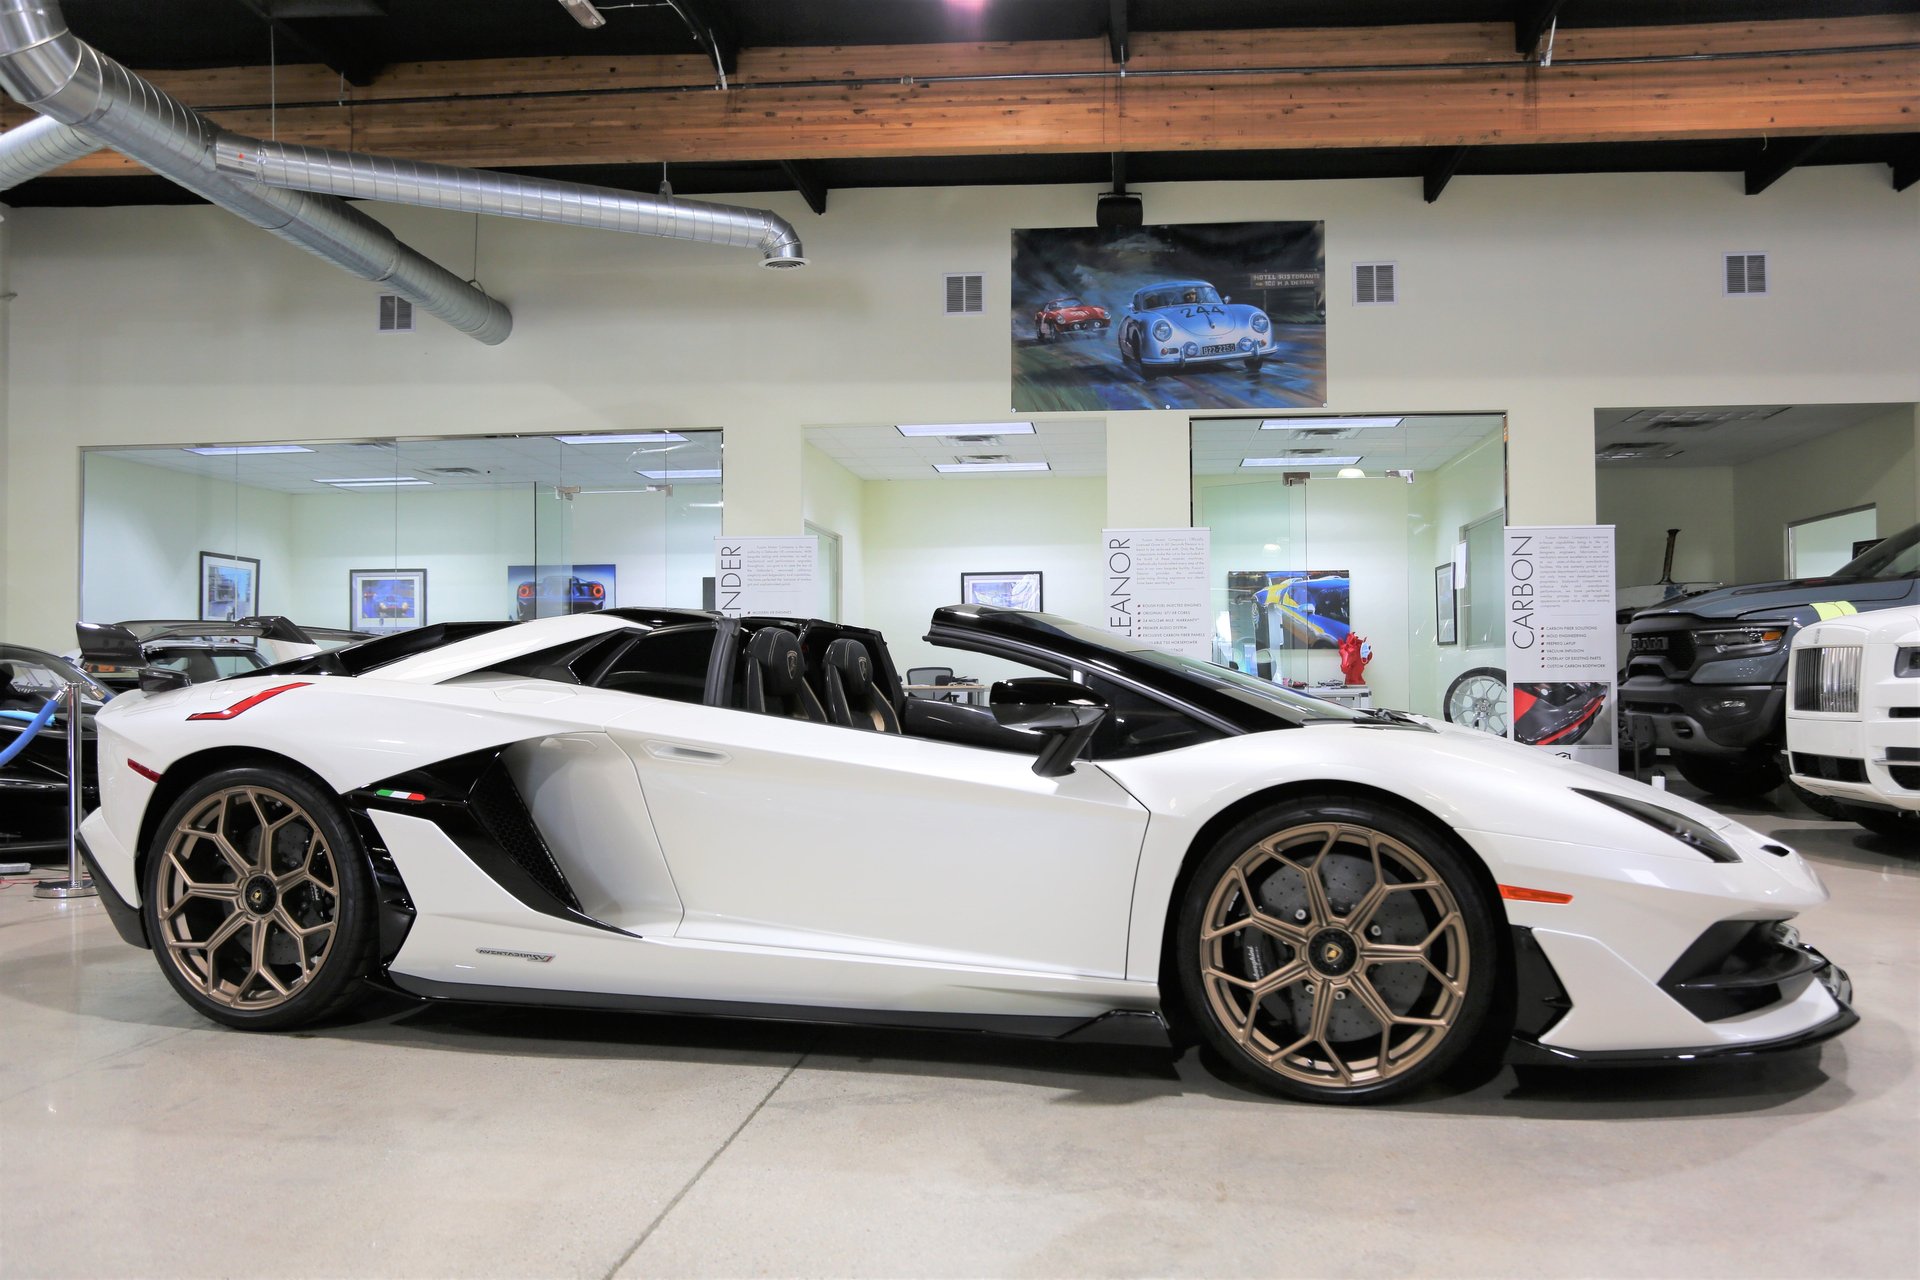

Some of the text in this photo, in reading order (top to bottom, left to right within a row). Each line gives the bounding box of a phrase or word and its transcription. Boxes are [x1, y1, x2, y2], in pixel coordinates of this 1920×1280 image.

[1180, 306, 1224, 318] 244
[1510, 536, 1534, 650] CARBON
[1632, 637, 1668, 650] RAM
